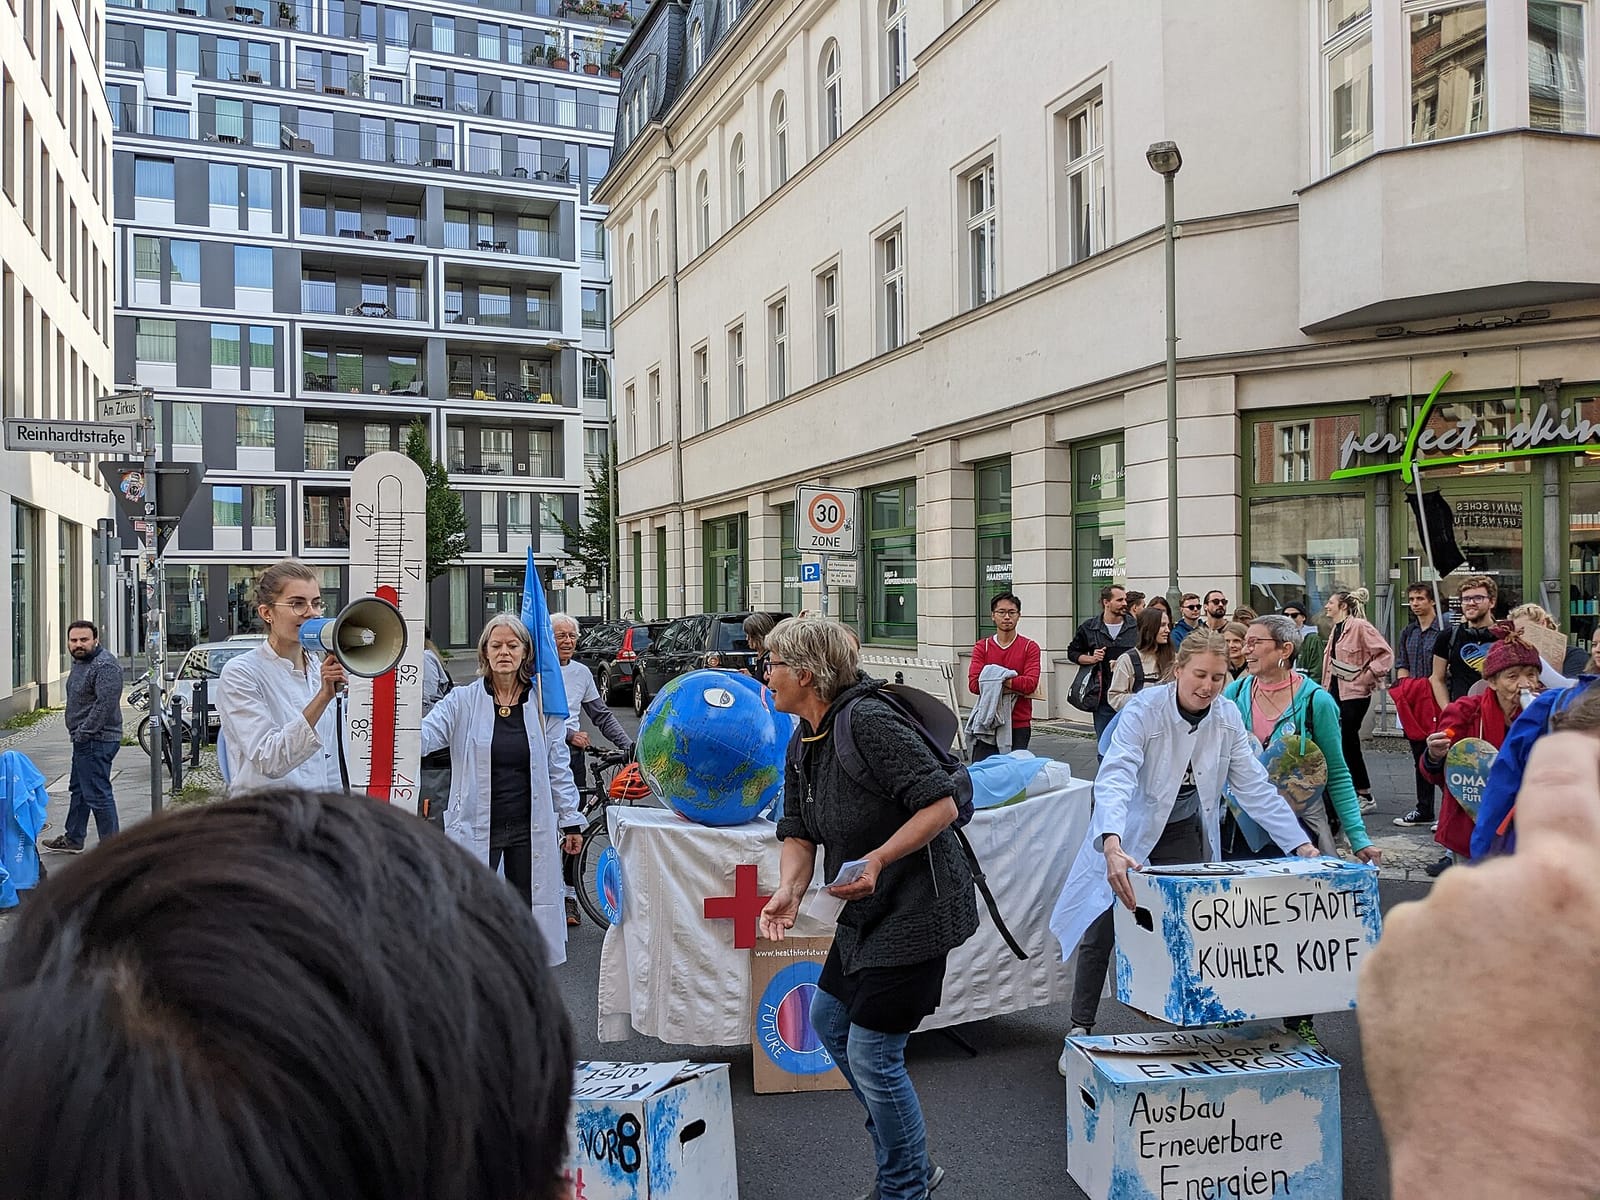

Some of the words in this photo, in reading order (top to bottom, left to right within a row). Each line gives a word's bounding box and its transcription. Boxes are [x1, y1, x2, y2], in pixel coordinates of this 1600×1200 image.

[103, 403, 114, 416] Am
[115, 401, 136, 415] Zirkus
[17, 425, 125, 446] Reinhardtstraße
[1506, 402, 1600, 449] skin
[355, 503, 374, 528] 42
[816, 504, 838, 523] 30
[811, 535, 841, 547] ZONE
[404, 559, 422, 580] 41
[804, 566, 815, 580] P
[400, 664, 418, 685] 39
[351, 718, 369, 741] 38
[394, 773, 414, 800] 37
[1451, 773, 1489, 788] OMA
[1462, 786, 1478, 794] FOR
[1191, 886, 1280, 931] GRÜNE
[1285, 881, 1365, 923] STÄDTE
[1199, 942, 1284, 979] KÜHLER
[1297, 938, 1360, 974] KOPF
[762, 1003, 786, 1059] FUTURE
[1129, 1087, 1225, 1126] Ausbau
[1140, 1119, 1283, 1159] Erneuerbare
[1160, 1165, 1290, 1200] Energien
